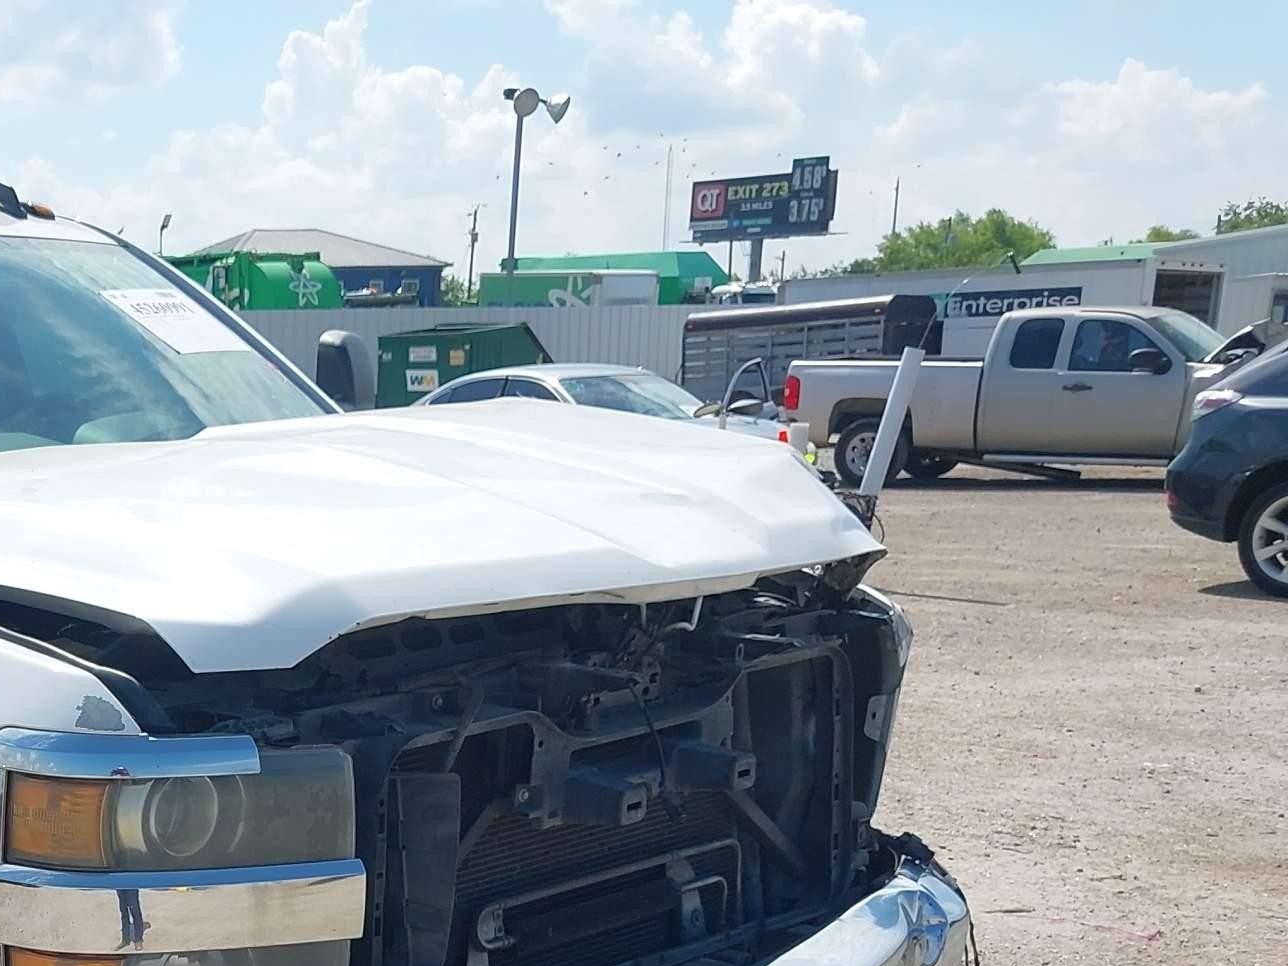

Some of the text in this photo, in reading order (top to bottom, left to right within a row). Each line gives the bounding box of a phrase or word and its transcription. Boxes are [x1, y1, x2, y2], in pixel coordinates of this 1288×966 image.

[697, 189, 721, 213] QT
[727, 181, 789, 200] EXIT 273
[947, 291, 1080, 316] Enterprise
[410, 375, 435, 387] WM
